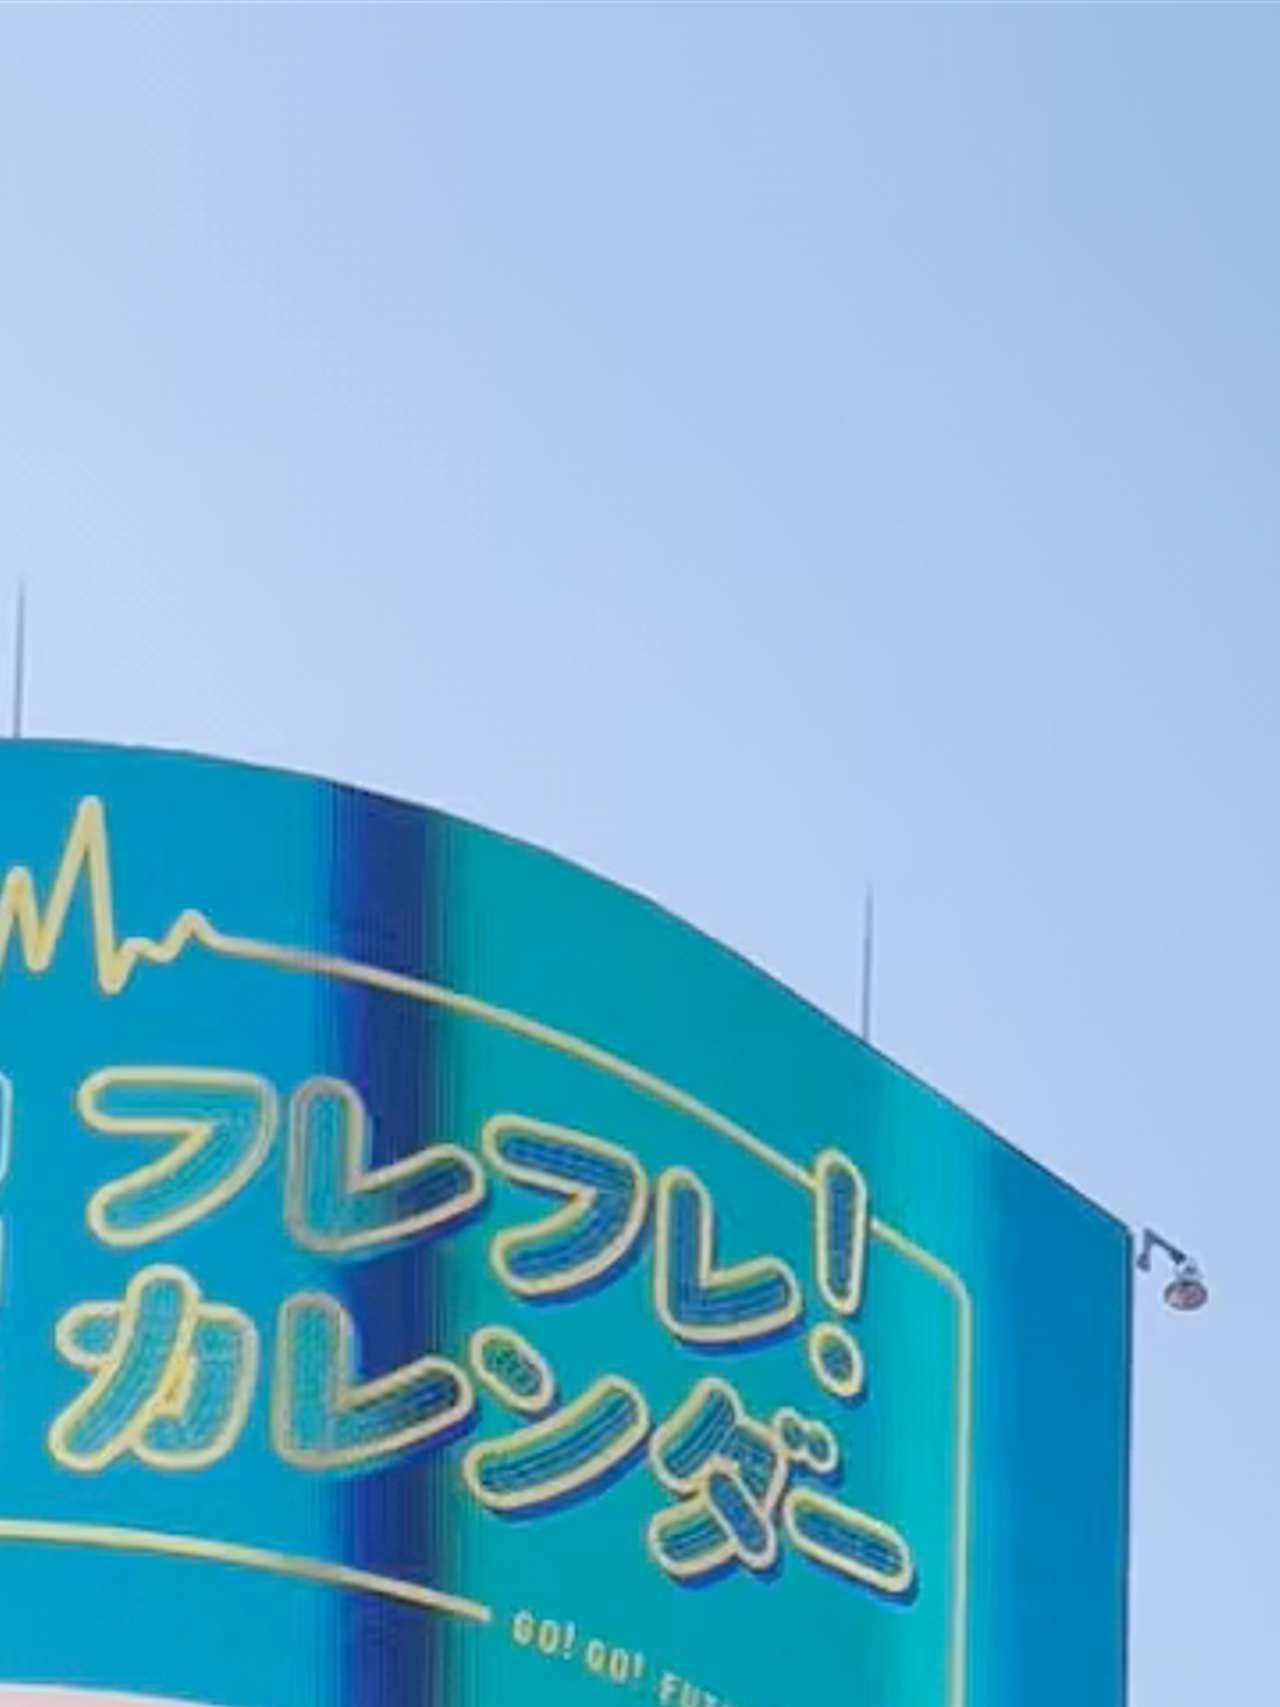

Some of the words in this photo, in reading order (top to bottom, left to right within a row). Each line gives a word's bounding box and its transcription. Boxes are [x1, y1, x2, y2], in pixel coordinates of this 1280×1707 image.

[48, 1264, 912, 1592] カレンダー
